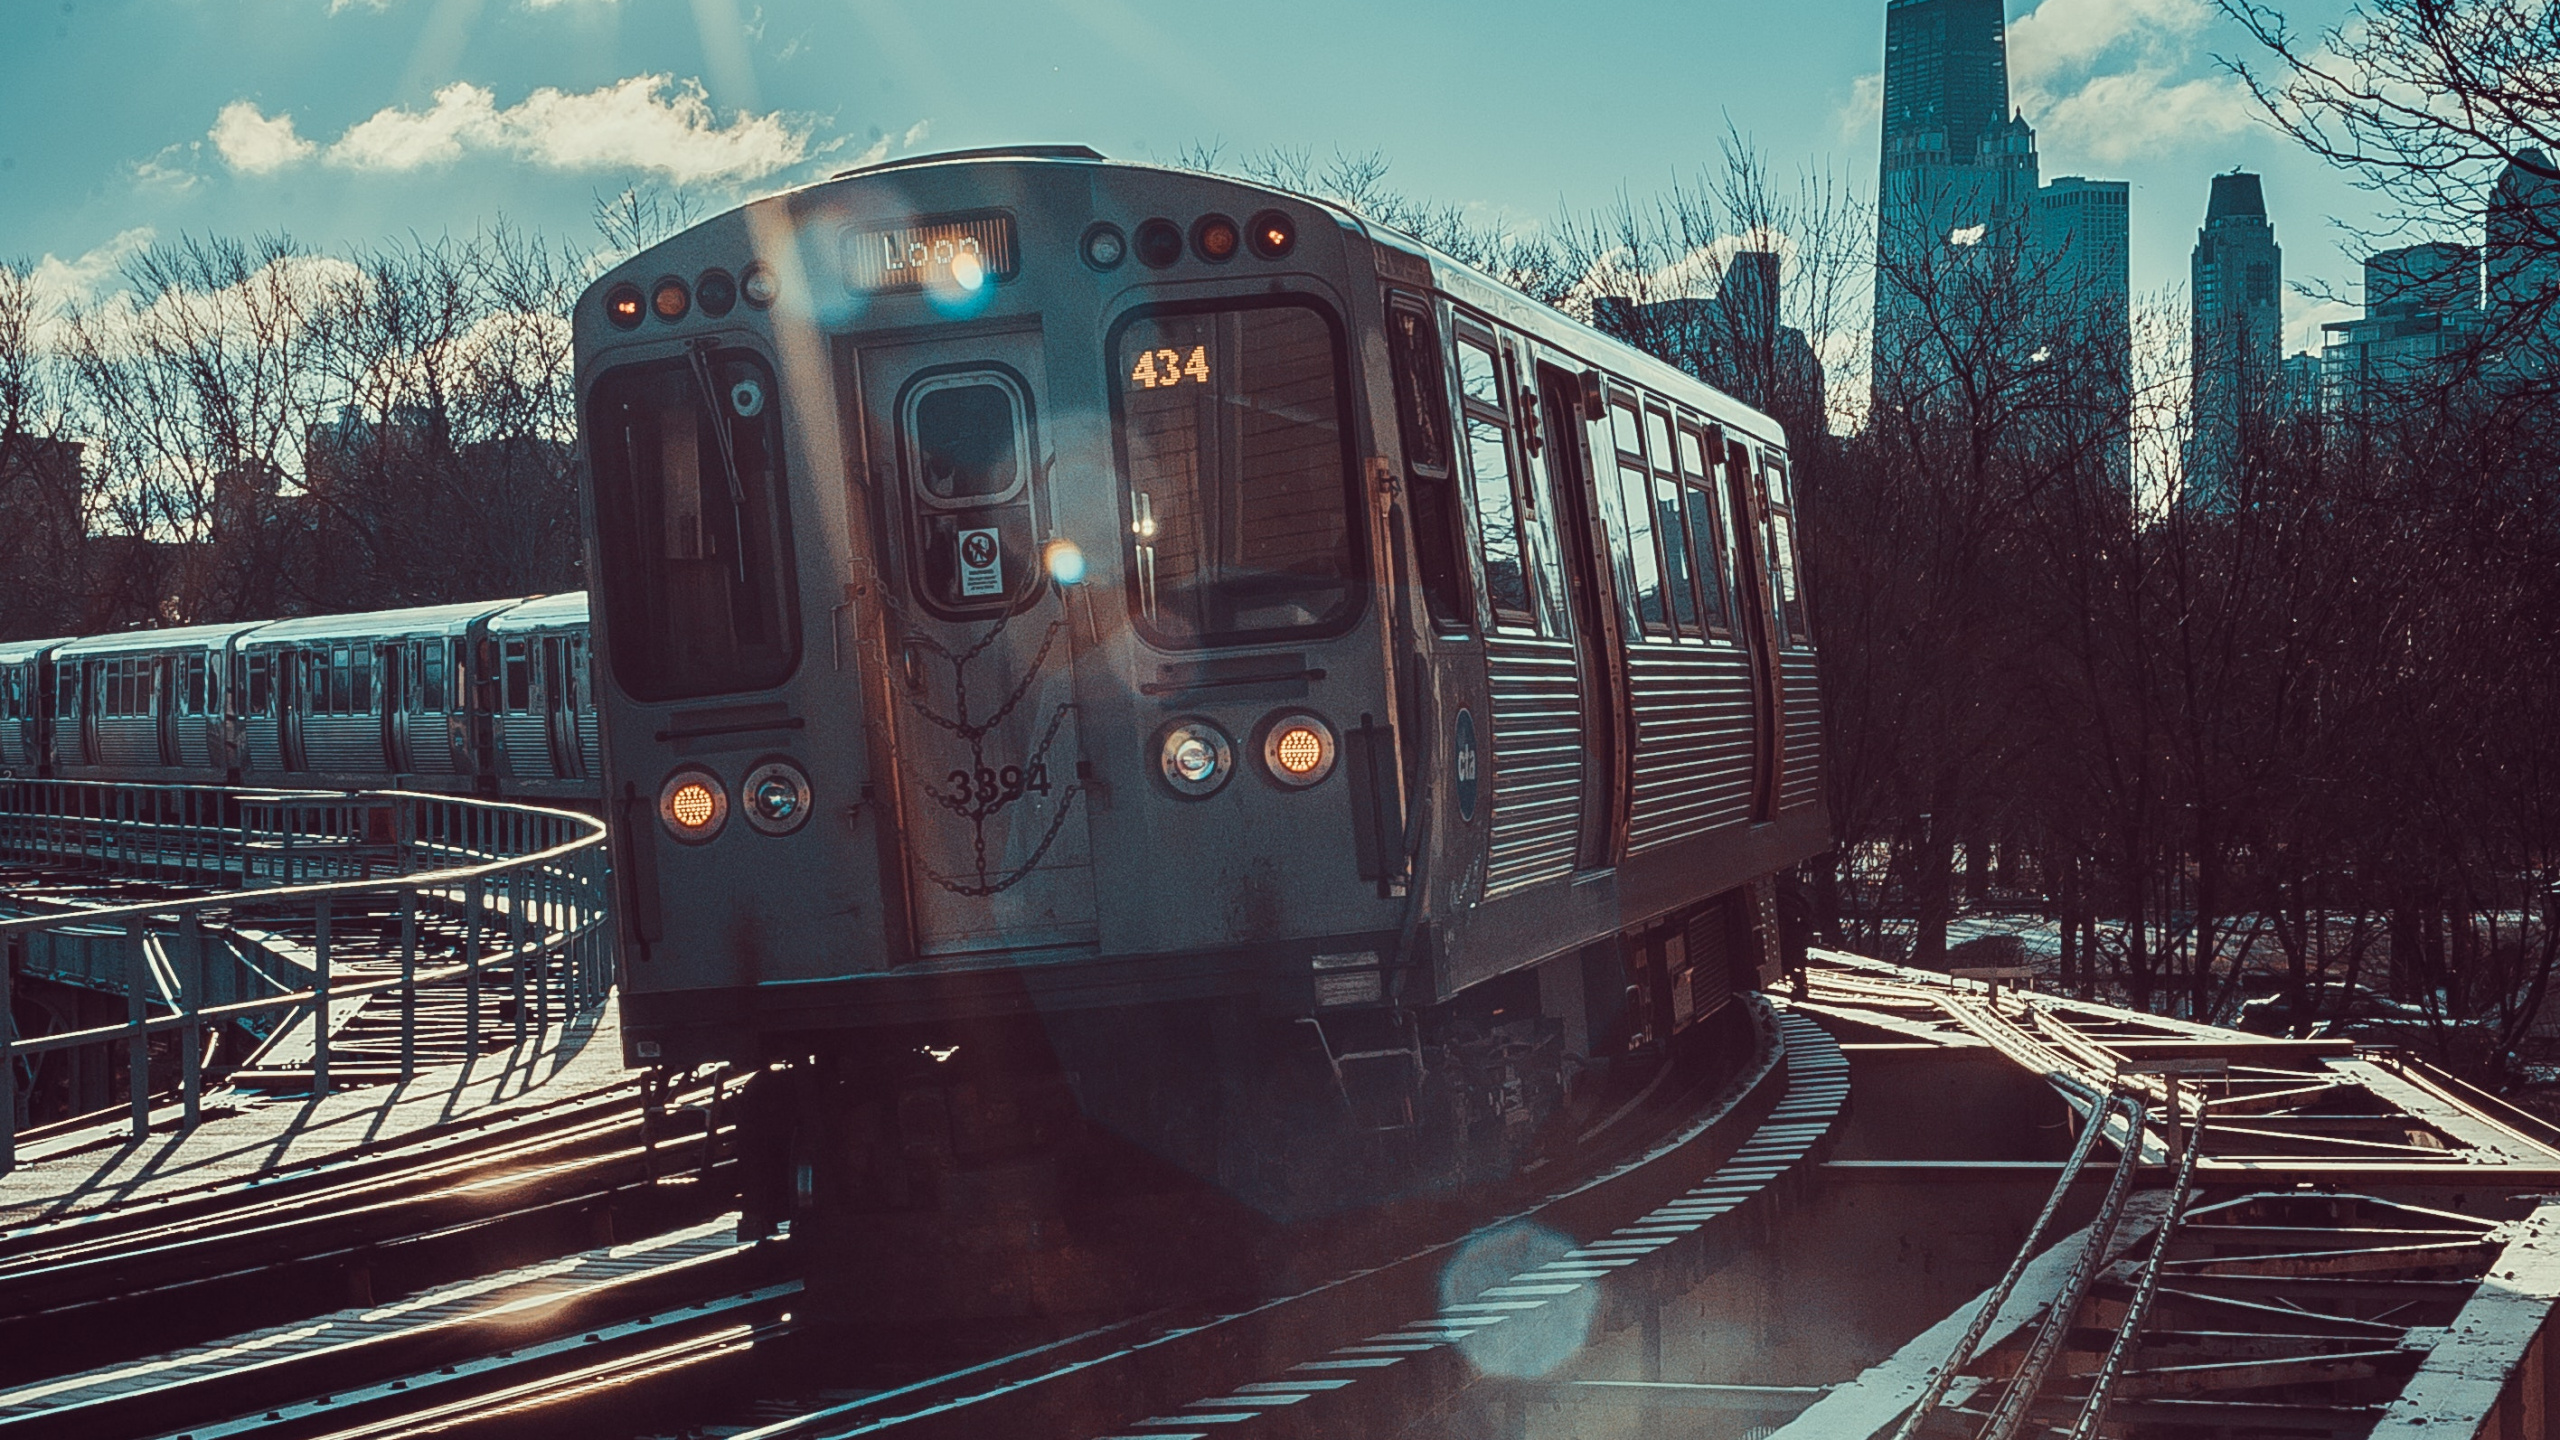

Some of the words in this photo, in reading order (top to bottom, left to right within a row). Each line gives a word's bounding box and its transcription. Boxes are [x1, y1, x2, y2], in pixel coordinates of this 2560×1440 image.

[1132, 346, 1209, 388] 434
[946, 762, 1052, 804] 3894
[1458, 743, 1476, 782] cta
